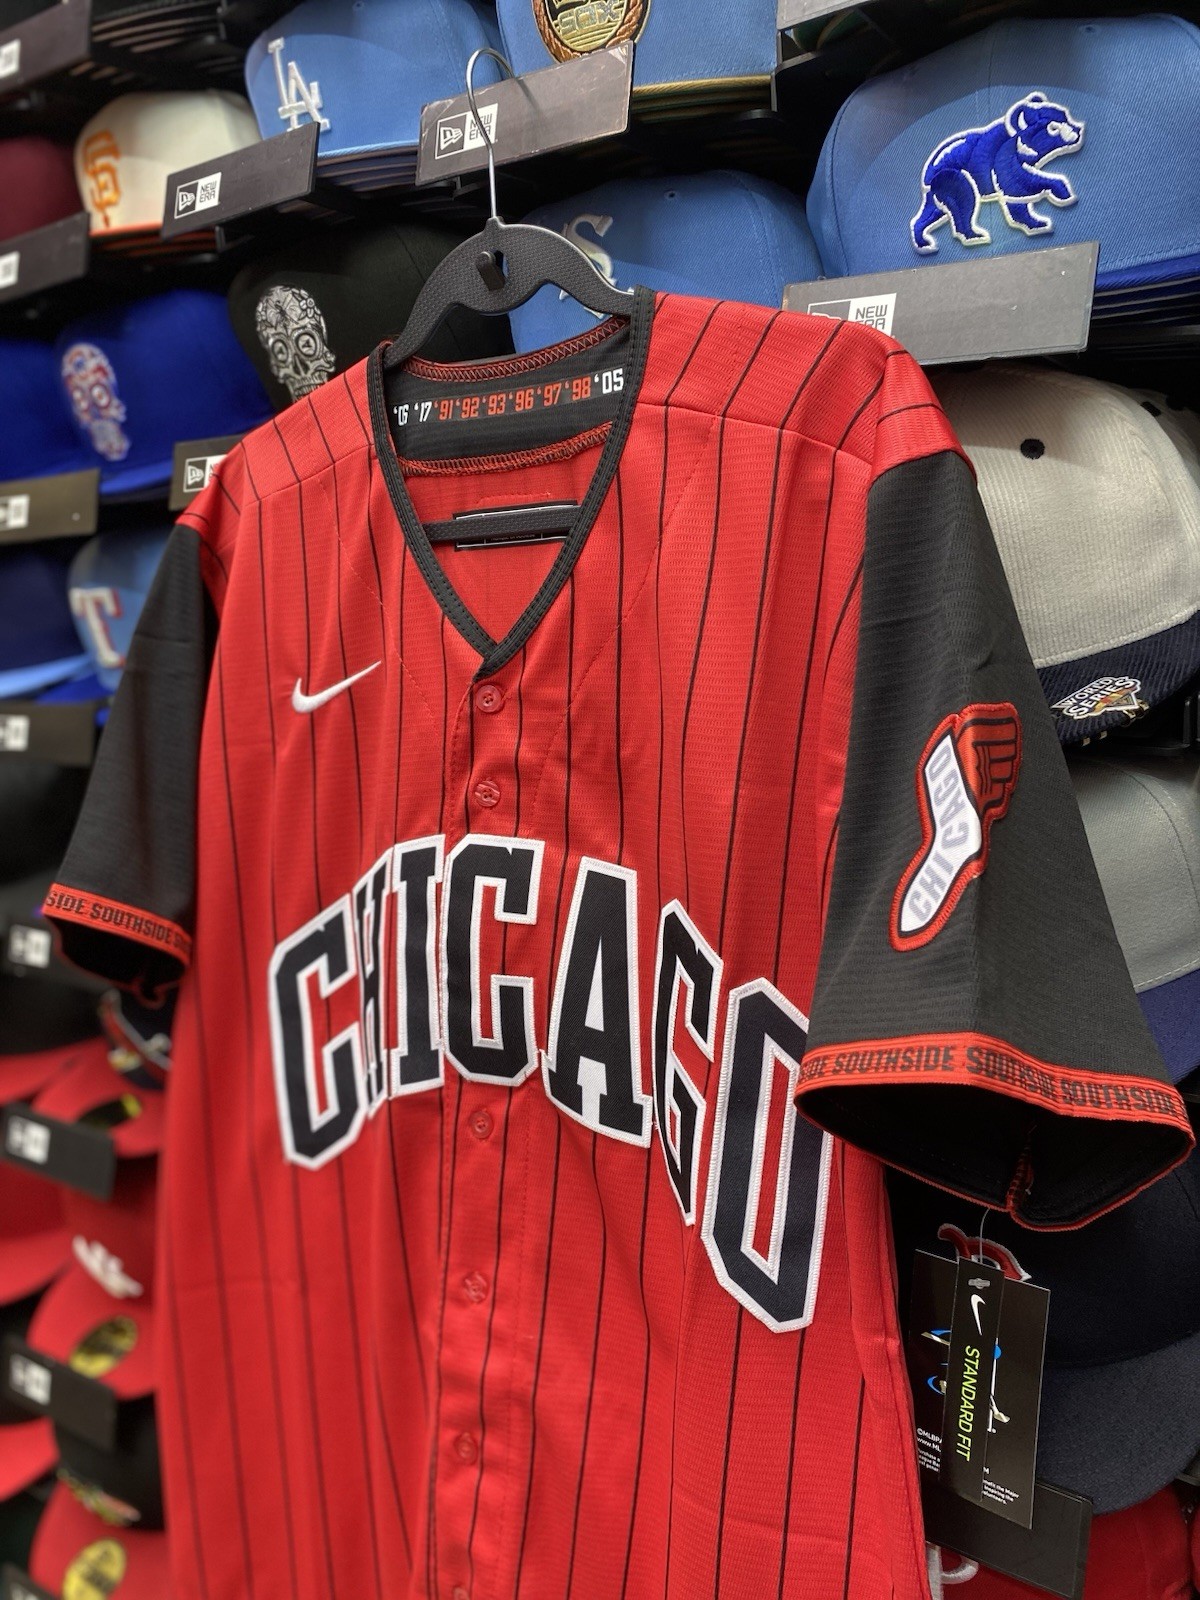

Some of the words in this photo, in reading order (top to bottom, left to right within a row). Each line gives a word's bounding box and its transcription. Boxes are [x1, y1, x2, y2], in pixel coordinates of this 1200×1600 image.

[268, 37, 331, 132] LA
[470, 113, 493, 129] NW
[199, 190, 216, 203] ERA
[200, 181, 218, 192] NEW
[855, 304, 888, 320] NEW
[1060, 678, 1113, 706] WORLD
[1069, 679, 1135, 715] SERIES
[907, 744, 970, 923] CHICAGO
[90, 902, 171, 943] SOUTHSIDE
[832, 1044, 957, 1075] SOUTHSIDE
[268, 833, 834, 1334] CHICAGO
[958, 1345, 981, 1434] STANDARD
[956, 1433, 972, 1462] FIT
